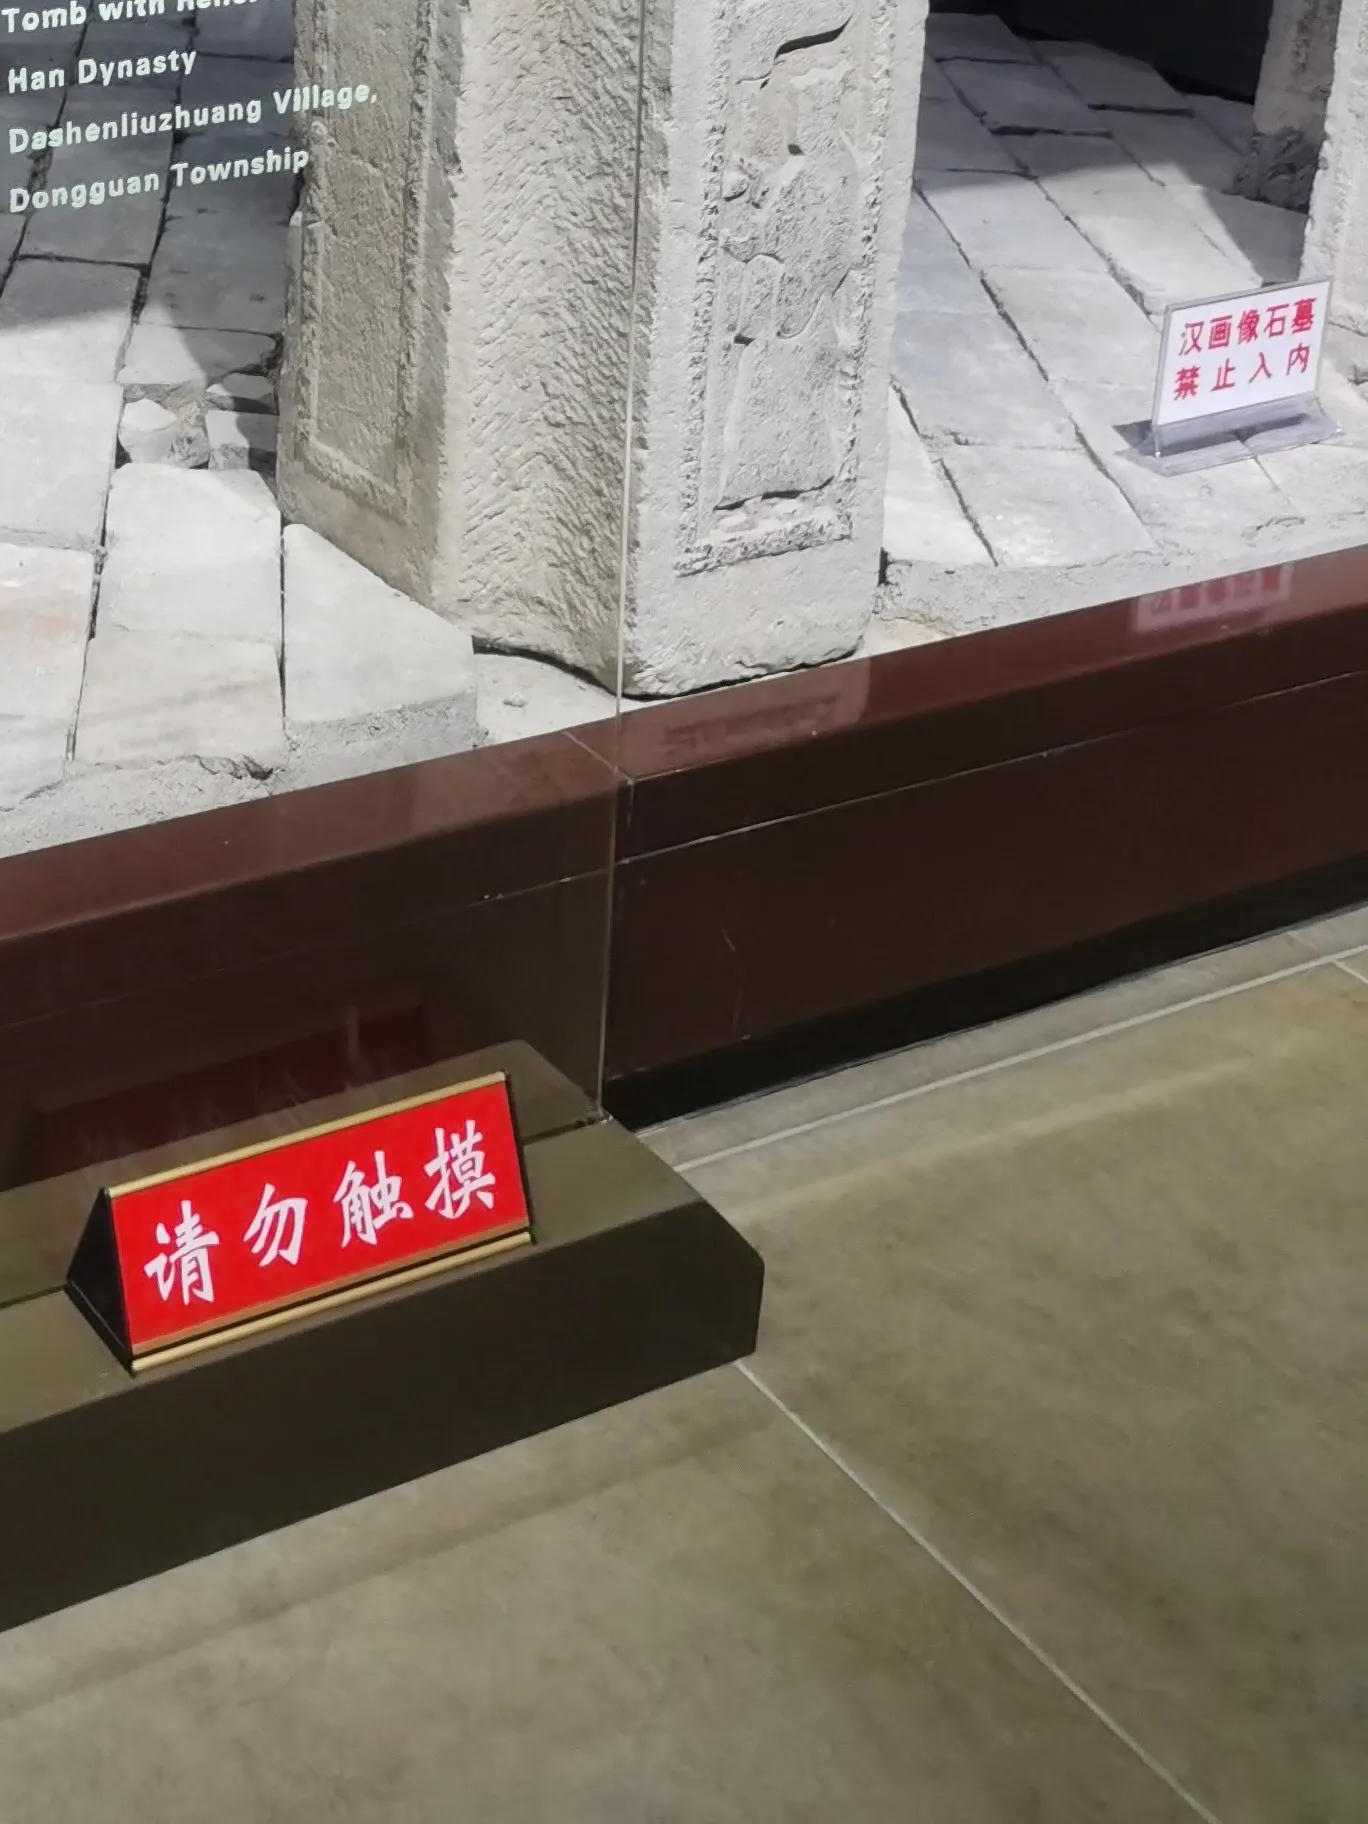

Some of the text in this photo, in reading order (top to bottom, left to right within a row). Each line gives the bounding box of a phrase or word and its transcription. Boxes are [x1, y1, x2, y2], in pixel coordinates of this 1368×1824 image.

[0, 0, 87, 34] Tomb
[7, 49, 197, 94] Han Dynasty
[8, 82, 378, 155] Dashenliuzhuang Village,
[9, 146, 310, 213] Dongguan Township
[1178, 296, 1317, 357] 汉画像石墓
[1173, 341, 1311, 401] 禁止入内
[142, 1118, 497, 1307] 请勿触摸
